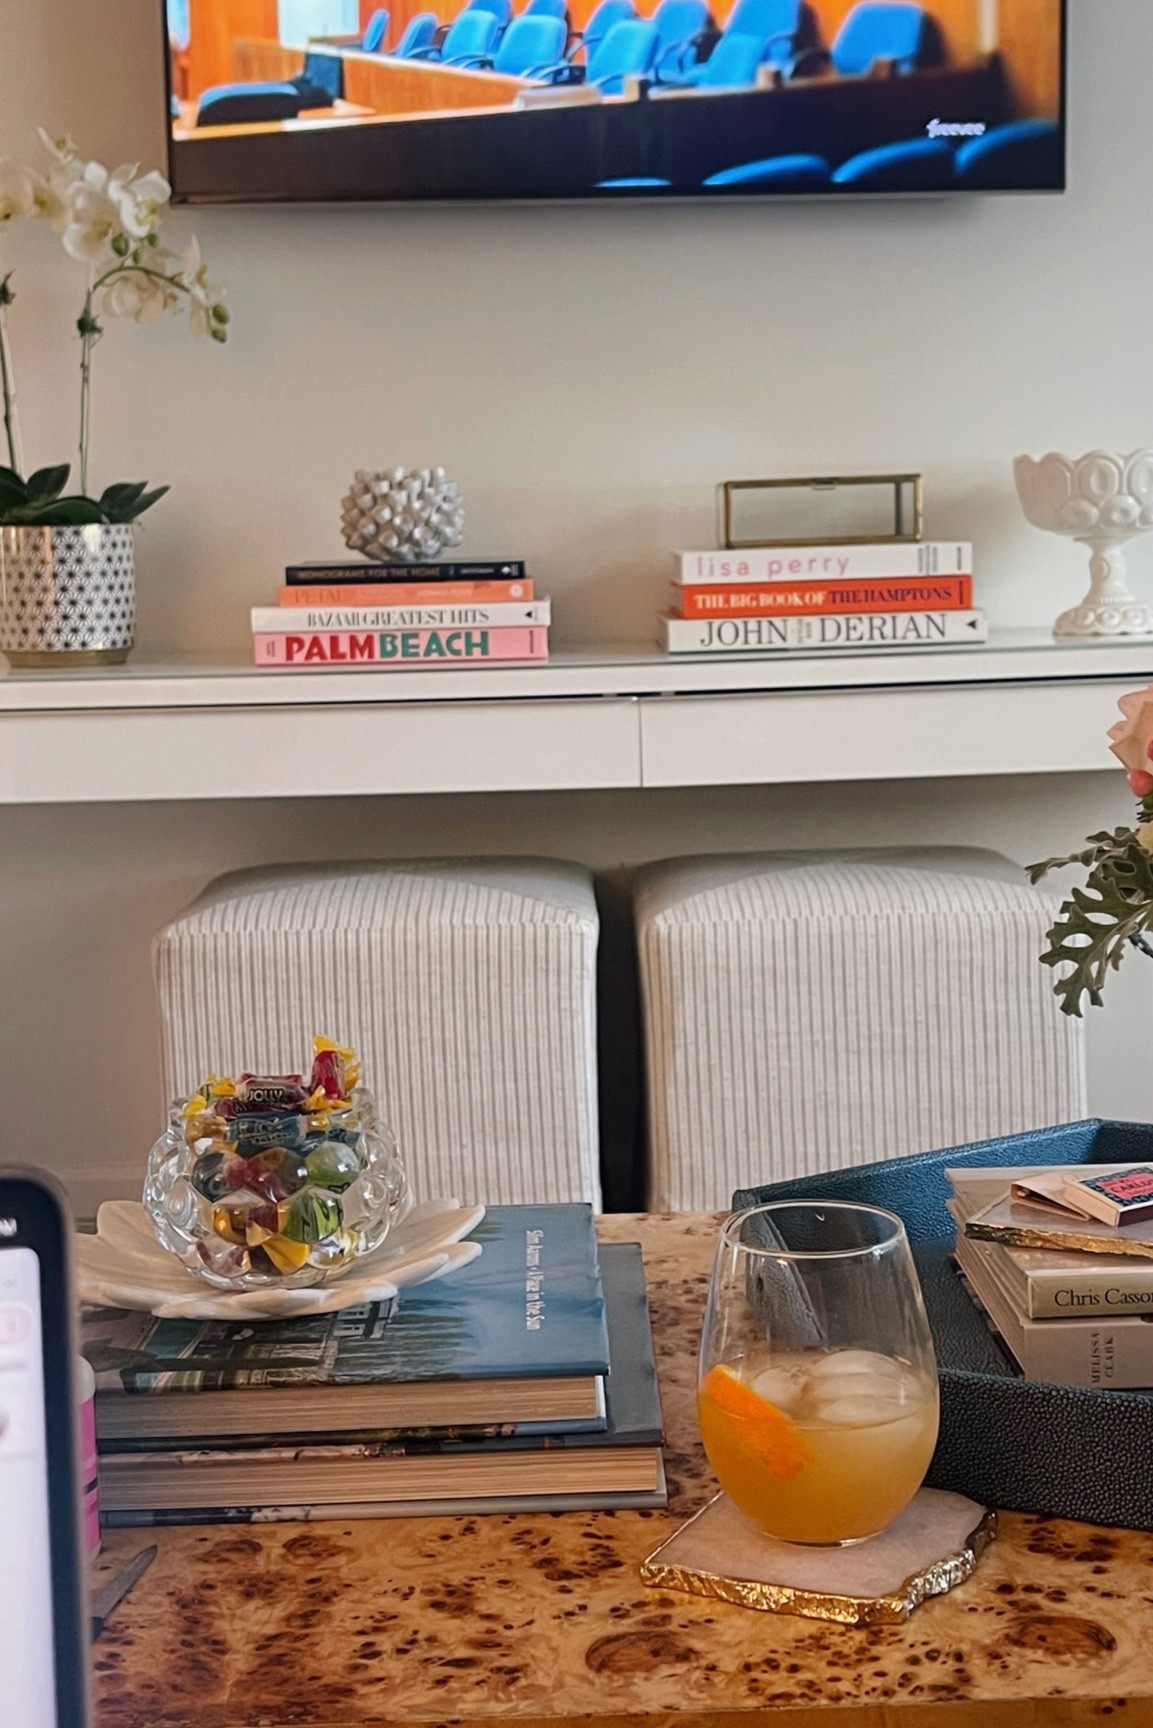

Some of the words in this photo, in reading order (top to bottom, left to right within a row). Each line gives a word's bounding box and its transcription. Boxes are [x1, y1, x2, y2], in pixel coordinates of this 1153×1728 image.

[697, 554, 749, 577] lisa
[767, 557, 850, 579] perry
[694, 593, 729, 609] THE
[730, 593, 758, 608] BIG
[759, 591, 803, 607] BOOK
[804, 591, 828, 605] OF
[829, 590, 863, 604] THE
[864, 587, 952, 603] HAMPTONS
[307, 611, 360, 627] BAZAAR
[362, 608, 447, 626] GREATEST
[451, 608, 490, 624] HITS
[700, 620, 788, 647] JOHN
[820, 614, 947, 642] DERIAN
[286, 633, 375, 661] PALM
[379, 631, 489, 658] BEACH
[248, 1088, 283, 1102] JOLLY
[1054, 1288, 1100, 1307] Chris
[526, 1315, 545, 1331] Sun
[1091, 1332, 1101, 1384] MELISSA
[1105, 1336, 1115, 1378] CLARK
